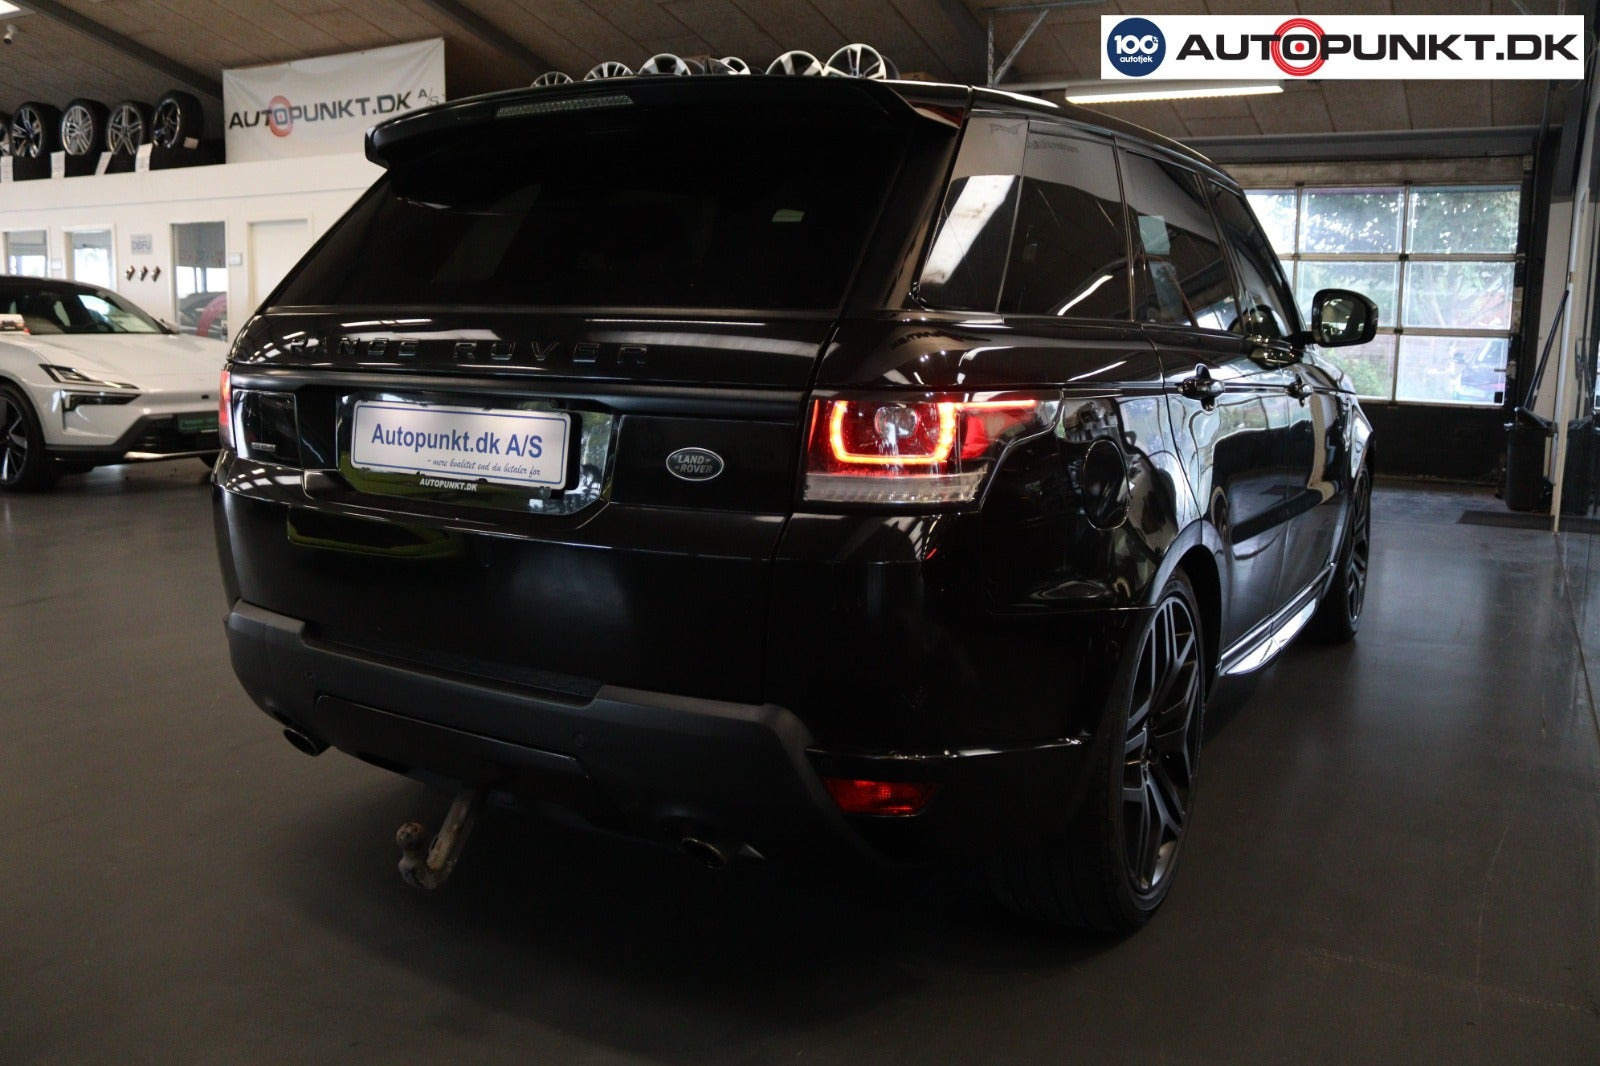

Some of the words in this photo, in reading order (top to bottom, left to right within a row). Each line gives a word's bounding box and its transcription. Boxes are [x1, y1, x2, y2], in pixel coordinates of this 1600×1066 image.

[229, 91, 412, 130] AUTOPUNKT.DK
[453, 340, 648, 366] ROVER
[371, 423, 500, 454] Autopunkt.dk
[505, 434, 543, 459] A/S
[450, 458, 476, 470] kvalitet
[478, 461, 490, 471] end
[492, 463, 501, 472] du
[504, 463, 527, 475] betaler
[529, 466, 540, 478] for
[677, 455, 705, 464] LAND
[680, 464, 713, 474] ROVER
[420, 478, 477, 491] AUTOPUNKT.DK
